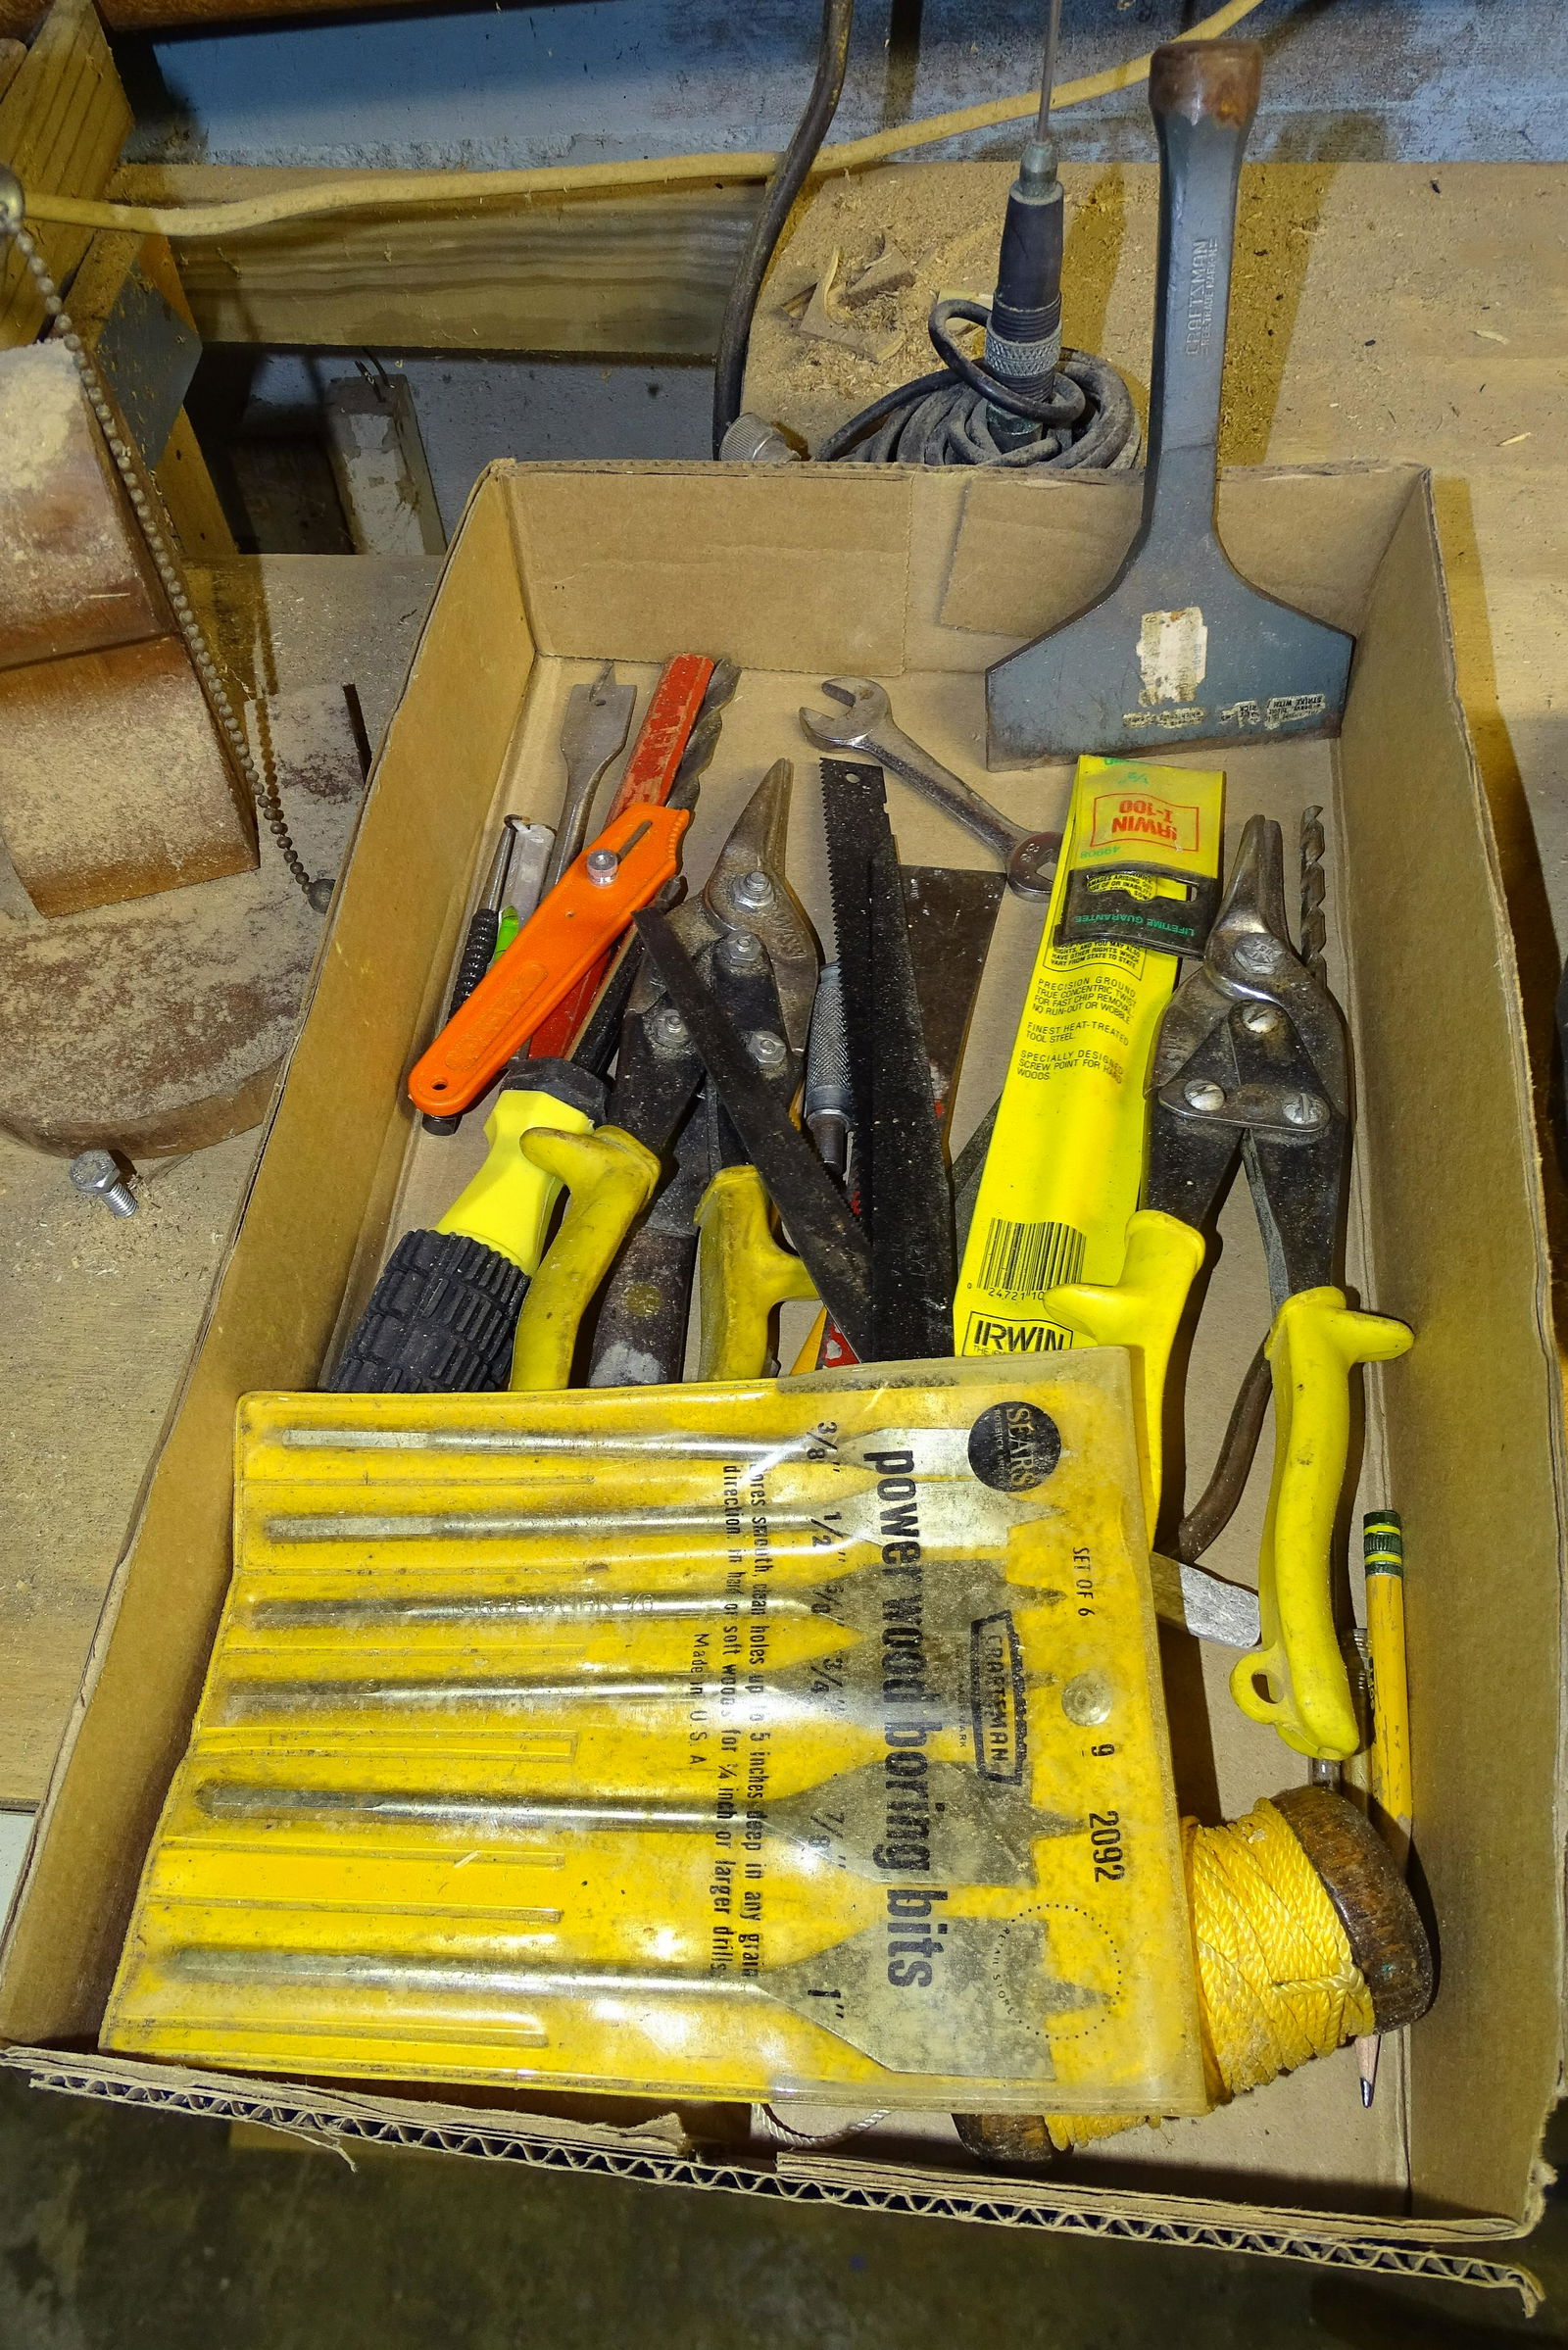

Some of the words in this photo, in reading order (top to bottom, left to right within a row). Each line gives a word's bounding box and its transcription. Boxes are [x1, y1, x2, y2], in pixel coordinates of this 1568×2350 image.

[1186, 241, 1207, 355] CRAFTSMAN
[1119, 800, 1172, 823] I-100
[1112, 815, 1177, 841] IRWIN
[1075, 914, 1144, 923] GUARANTEE
[1147, 918, 1196, 936] LIFETIME
[1119, 951, 1139, 962] WHICH
[1034, 995, 1051, 1005] FOR
[1074, 993, 1094, 1003] CHIP
[1037, 987, 1057, 999] TRUE
[1060, 985, 1112, 999] CONCENTRIC
[1115, 989, 1137, 1008] TWIST
[1038, 977, 1090, 992] PRECISION
[1032, 1004, 1043, 1013] NO
[1046, 1004, 1082, 1015] RUN-OUT
[1026, 1031, 1047, 1043] TOOL
[1027, 1022, 1060, 1035] FINEST
[1063, 1021, 1129, 1046] HEAT-TREATED
[1018, 1058, 1051, 1070] SCREW
[1054, 1058, 1079, 1070] POINT
[1082, 1059, 1101, 1069] FOR
[1103, 1064, 1122, 1084] HARD
[1020, 1051, 1073, 1062] SPECIALLY
[1077, 1050, 1123, 1075] DESIGNED
[974, 1320, 1064, 1352] IRWIN
[993, 1409, 1004, 1449] ROEBUCK
[808, 1421, 840, 1473] 3/8"
[1006, 1407, 1036, 1487] SEARS
[863, 1450, 926, 1583] power
[751, 1517, 772, 1578] smooth,
[1072, 1547, 1091, 1572] SET
[725, 1572, 745, 1593] hard
[1076, 1579, 1094, 1598] OF
[725, 1603, 740, 1615] or
[751, 1584, 770, 1615] clean
[1079, 1607, 1096, 1617] 6
[690, 1634, 710, 1674] Made
[723, 1626, 744, 1655] soft
[751, 1625, 768, 1664] holes
[881, 1595, 941, 1703] wood
[689, 1682, 707, 1695] in
[719, 1664, 741, 1717] woods
[746, 1676, 764, 1693] up
[986, 1635, 1008, 1762] CRAFTSMAN
[720, 1729, 741, 1753] for
[751, 1732, 770, 1741] 5
[1091, 1743, 1114, 1757] 9
[748, 1751, 769, 1798] inches
[715, 1787, 740, 1819] inch
[874, 1723, 948, 1875] boring
[715, 1831, 733, 1849] or
[741, 1810, 768, 1851] deep
[1088, 1810, 1125, 1883] 2092
[745, 1863, 767, 1879] in
[710, 1860, 736, 1914] larger
[740, 1891, 763, 1921] any
[887, 1889, 949, 1989] bits
[992, 1927, 1010, 1965] RETAIL
[739, 1934, 765, 1978] grain
[807, 1984, 843, 2020] 1"
[993, 1975, 1013, 2016] STORE
